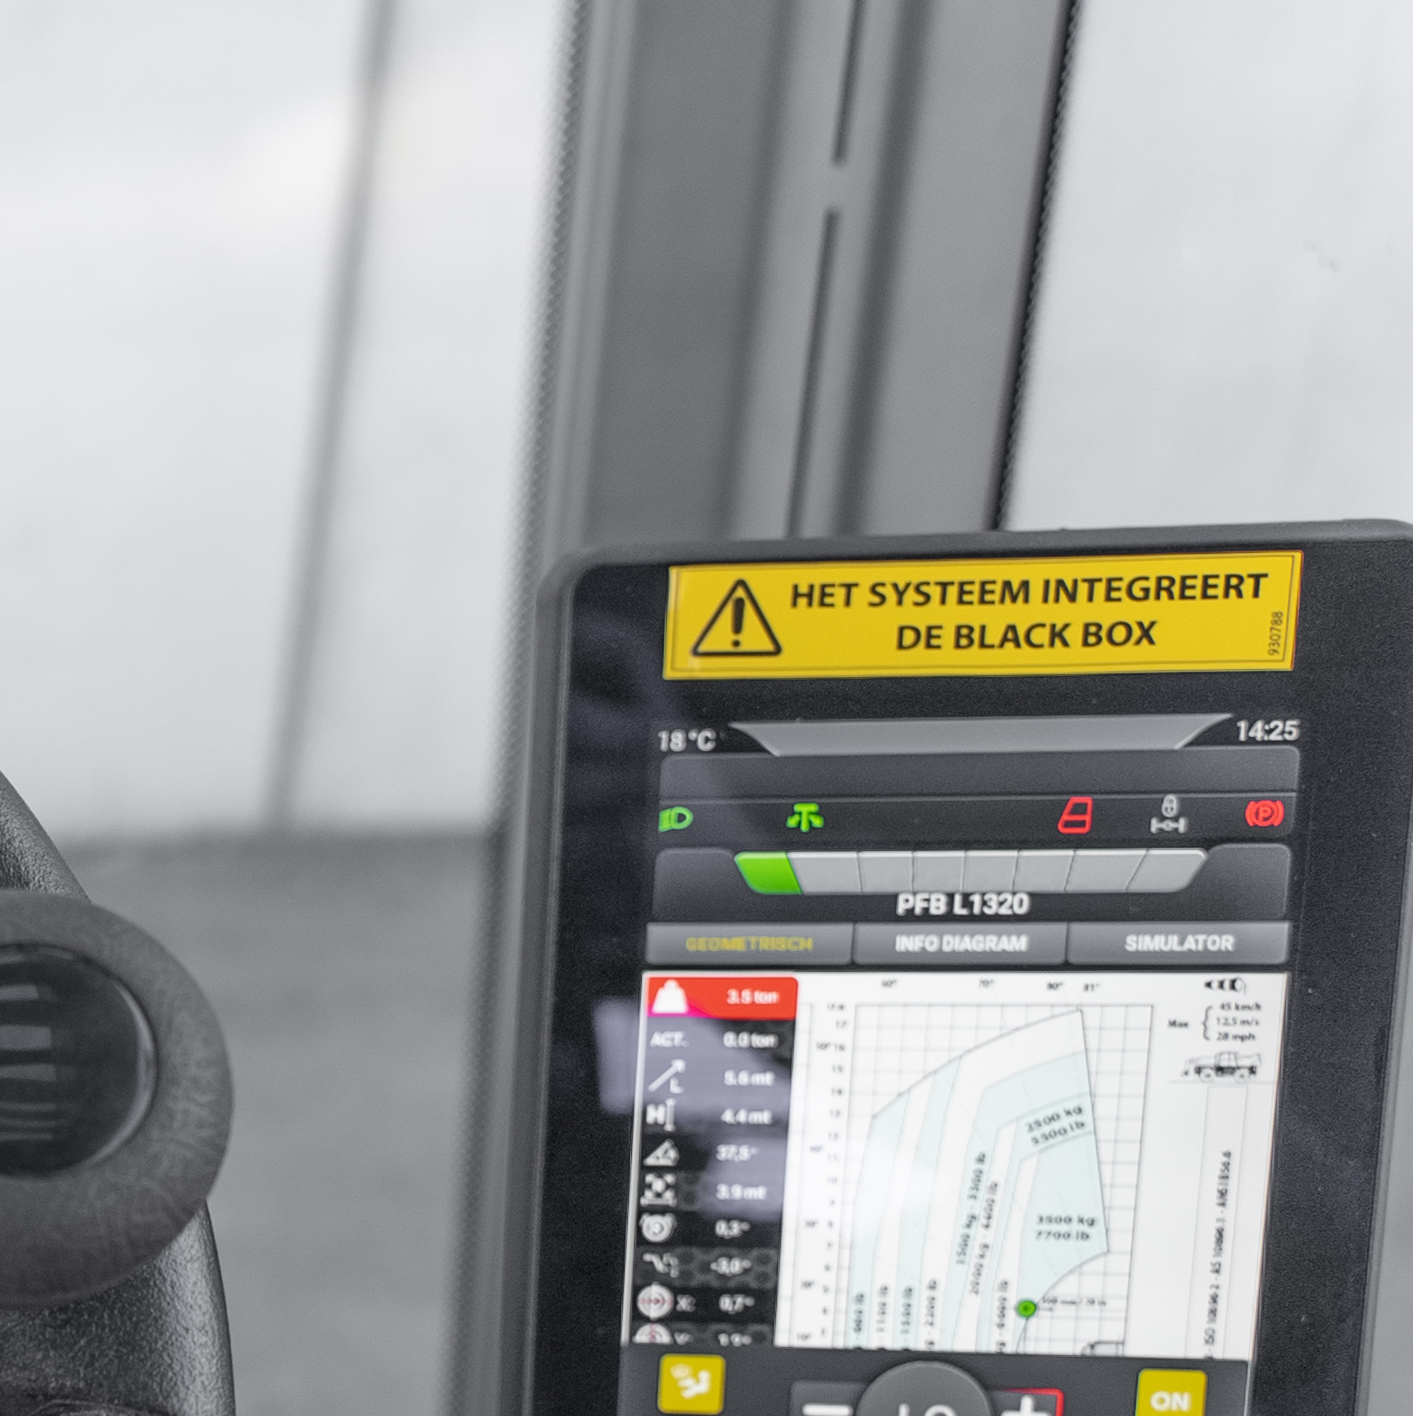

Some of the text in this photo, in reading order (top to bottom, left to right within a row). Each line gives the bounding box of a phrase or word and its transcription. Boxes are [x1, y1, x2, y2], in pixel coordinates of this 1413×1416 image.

[790, 573, 1268, 608] HET SYSTEEM INTEGREERT
[897, 620, 1157, 650] DE BLACK BOX
[1268, 611, 1283, 656] 930788
[1236, 720, 1300, 742] 14:25
[896, 892, 1030, 916] PFB L1320
[685, 936, 814, 952] GEOMETRISCH
[895, 933, 1029, 952] INFO DIAGRAM
[1124, 933, 1235, 952] SIMULATOR
[753, 989, 780, 1005] ton
[1234, 1002, 1262, 1011] km/h
[1149, 1390, 1192, 1412] ON
